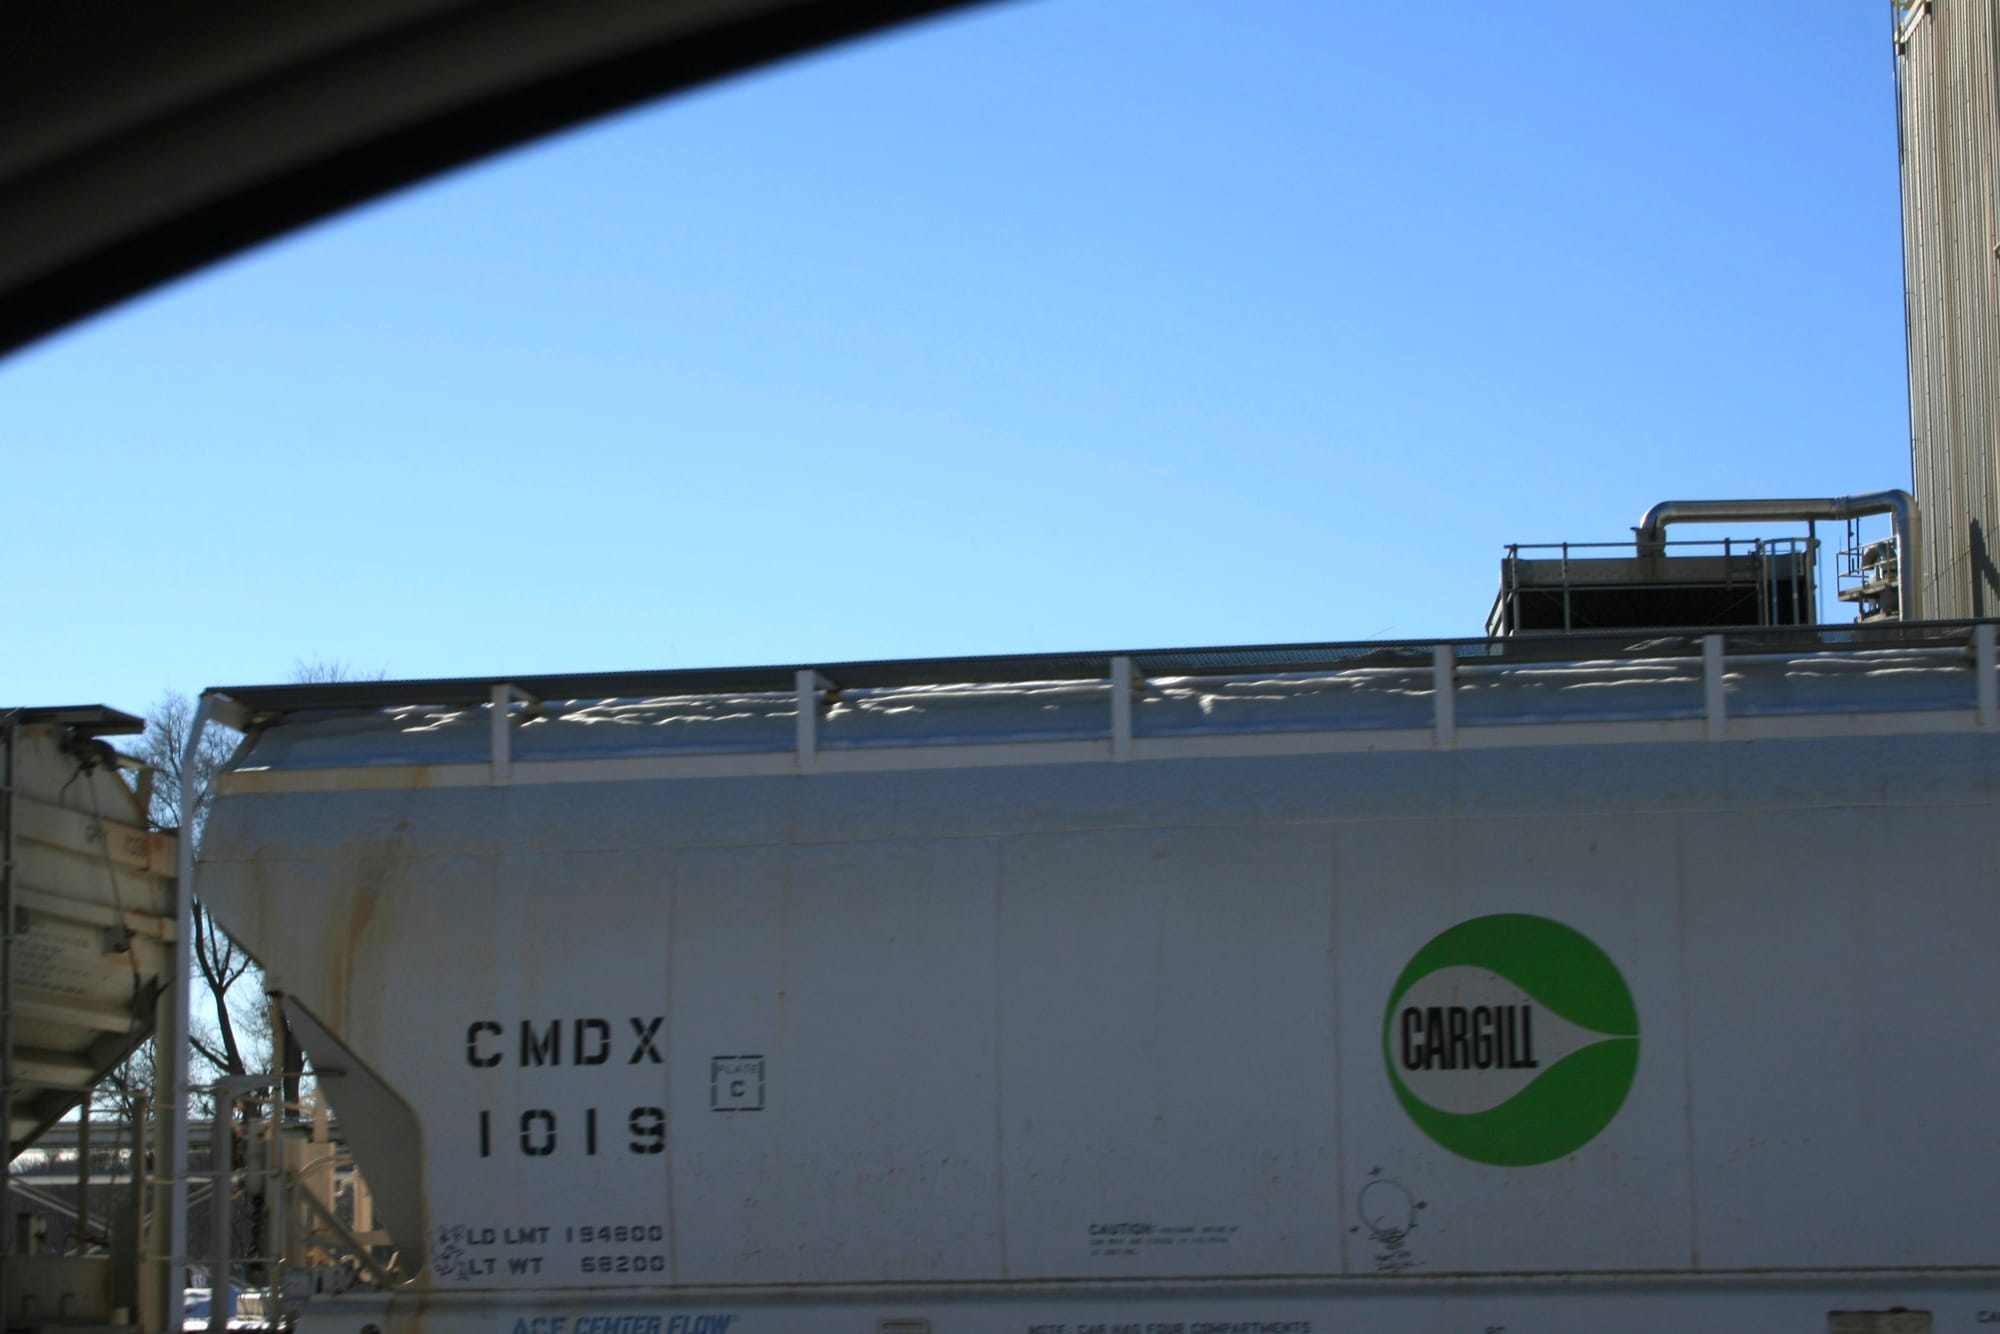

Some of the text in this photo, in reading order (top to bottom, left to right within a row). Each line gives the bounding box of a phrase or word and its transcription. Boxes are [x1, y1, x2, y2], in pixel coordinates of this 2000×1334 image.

[466, 1016, 665, 1068] CMDX
[1401, 1005, 1539, 1071] CARGILL
[730, 1080, 745, 1097] C
[479, 1107, 666, 1157] 1019
[468, 1228, 496, 1245] LD
[504, 1227, 550, 1244] LMT
[469, 1258, 496, 1275] LT
[508, 1257, 545, 1274] WT
[573, 1315, 662, 1334] CENTER
[666, 1314, 734, 1334] FLOW
[1189, 1321, 1313, 1334] COMPARTMENTS
